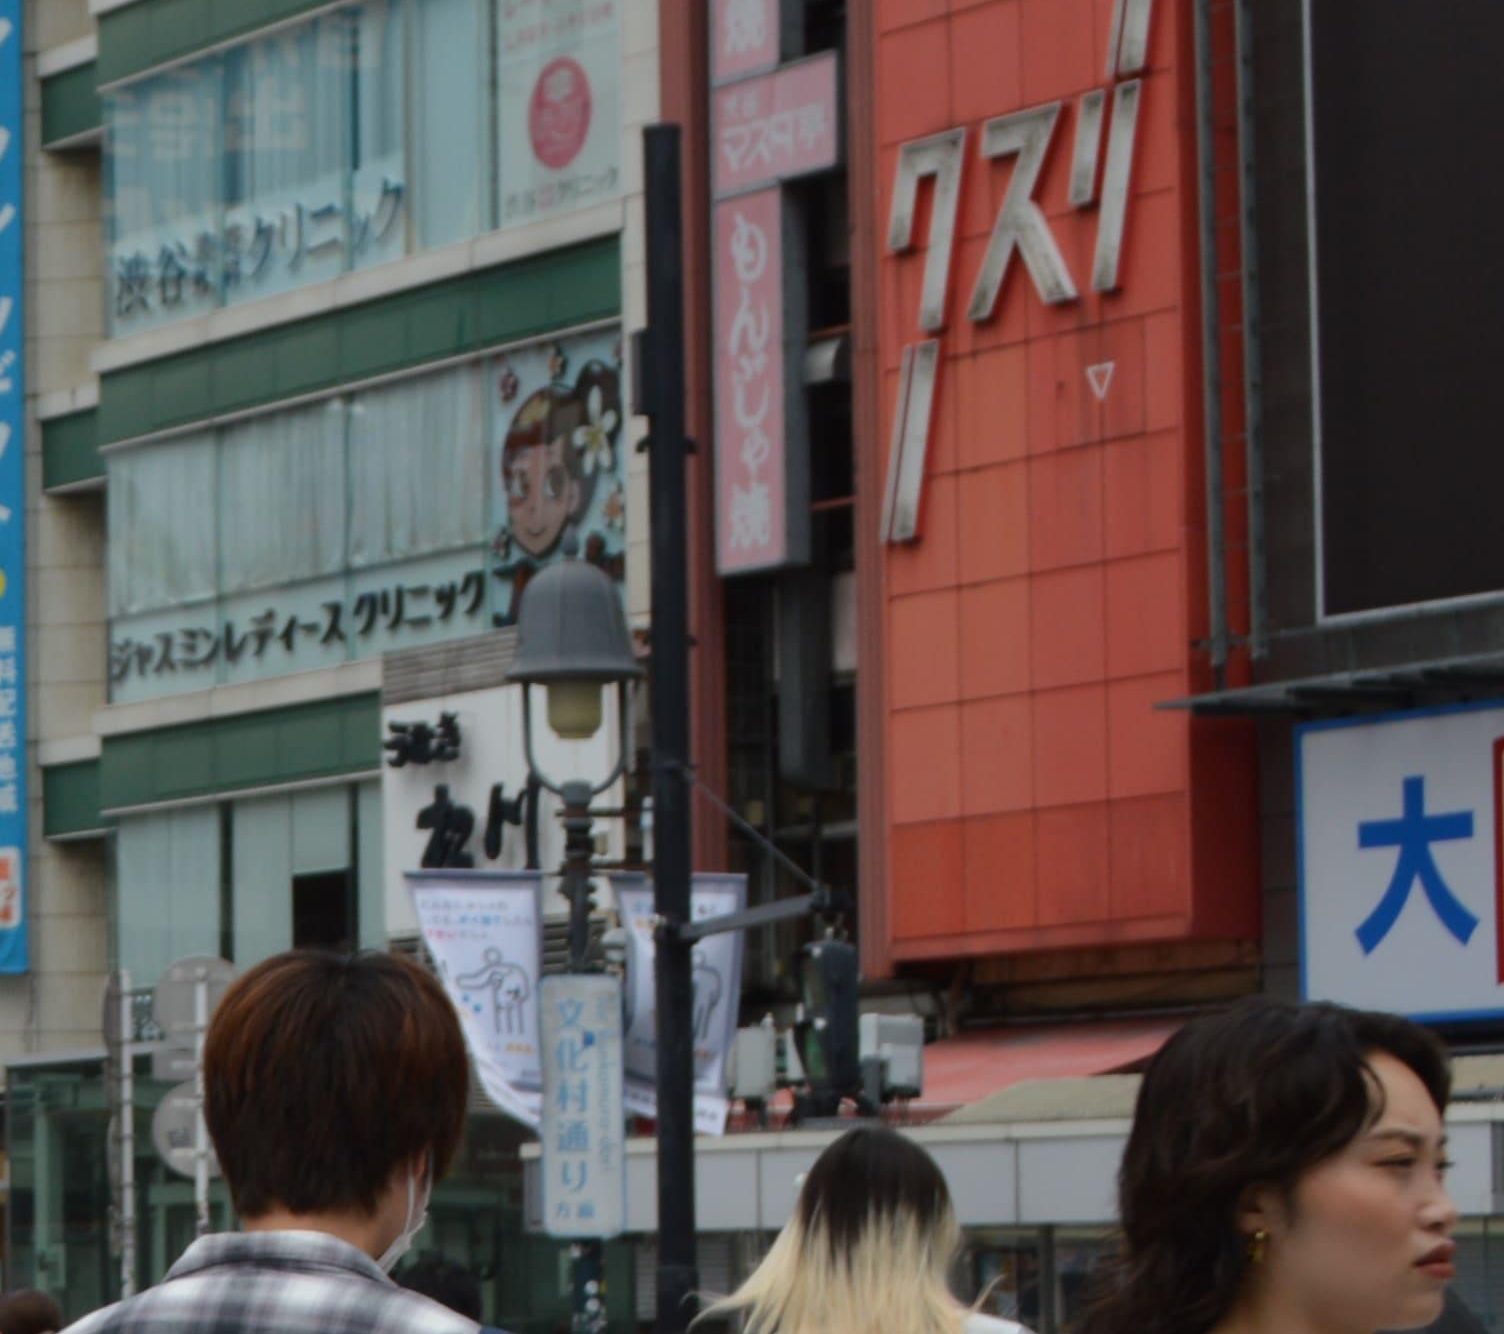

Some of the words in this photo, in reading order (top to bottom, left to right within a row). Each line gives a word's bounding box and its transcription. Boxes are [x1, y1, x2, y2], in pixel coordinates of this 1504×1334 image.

[108, 567, 486, 684] ジャスミンレディースクリニック
[1354, 775, 1480, 957] 大
[555, 998, 590, 1194] 文化村通り
